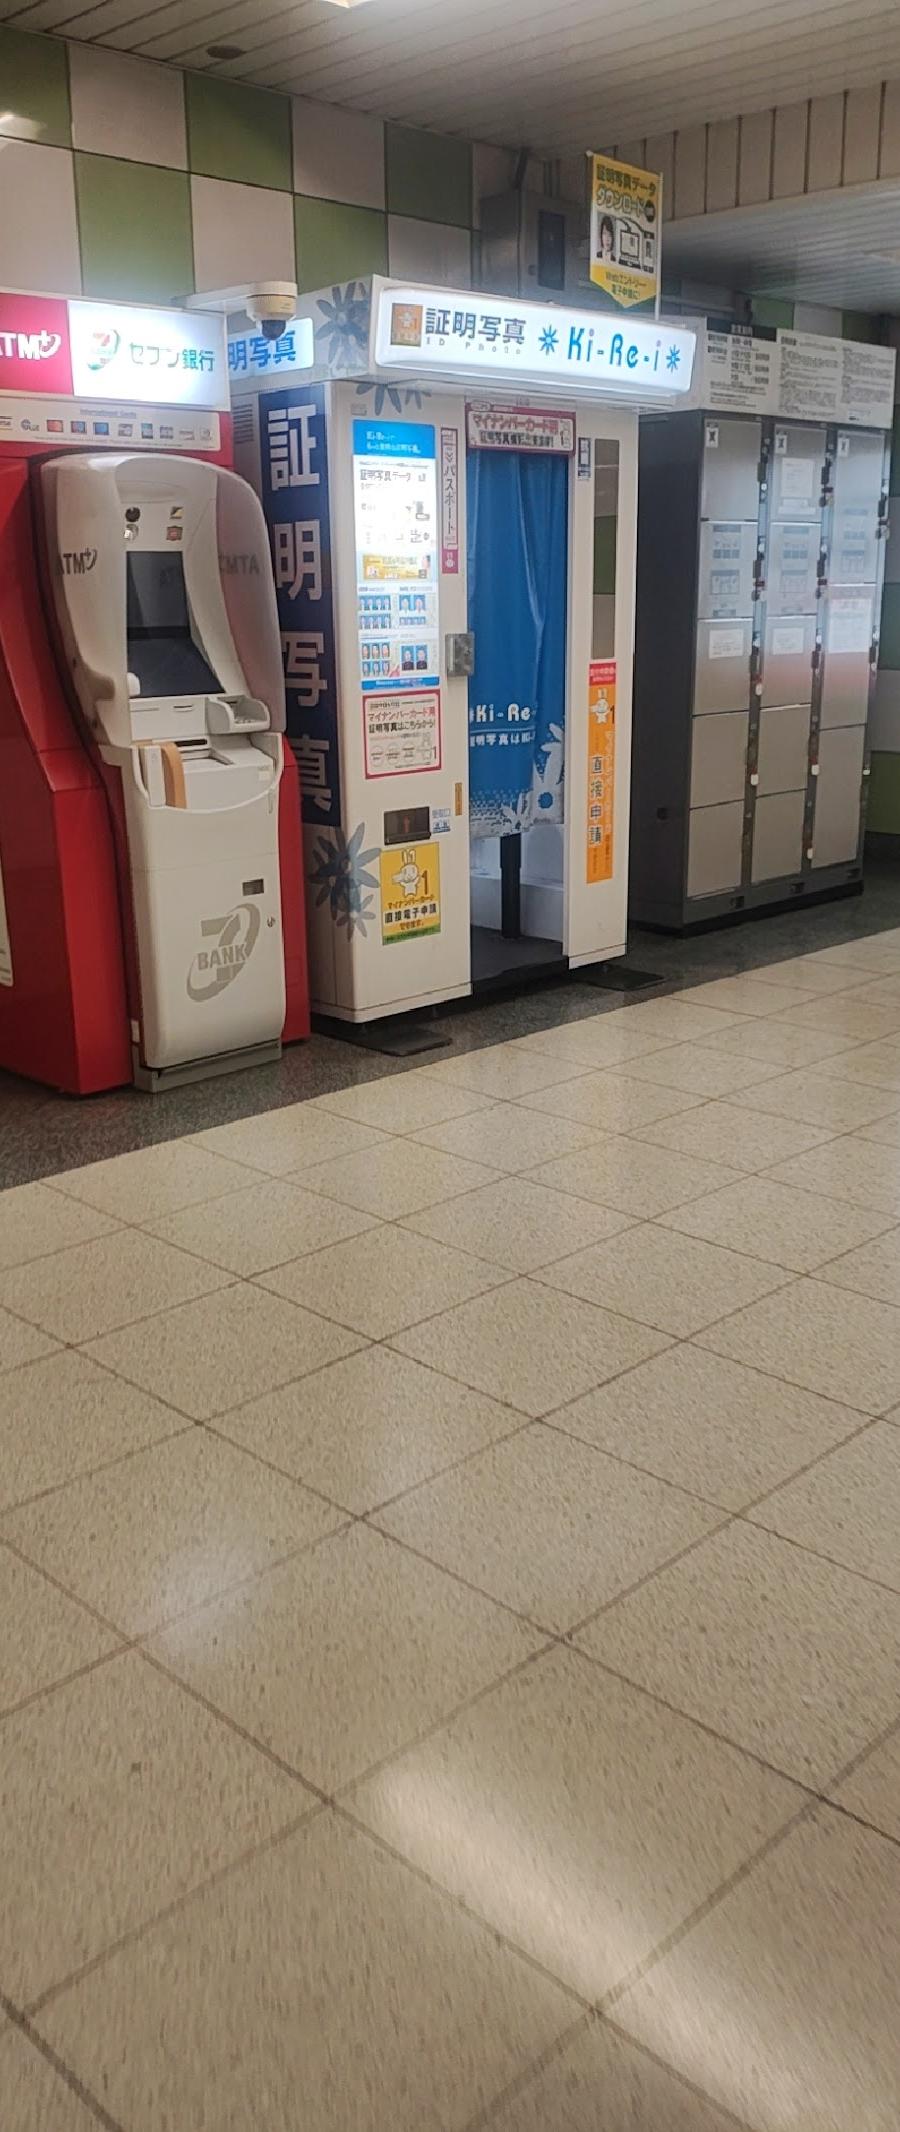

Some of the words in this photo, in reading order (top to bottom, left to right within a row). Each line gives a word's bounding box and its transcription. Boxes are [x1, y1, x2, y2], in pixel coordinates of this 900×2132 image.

[425, 308, 526, 345] 証明写真
[129, 341, 216, 372] セブン銀行
[267, 403, 333, 813] 証明写真
[588, 755, 603, 847] 直接申請
[197, 944, 246, 971] BANK
